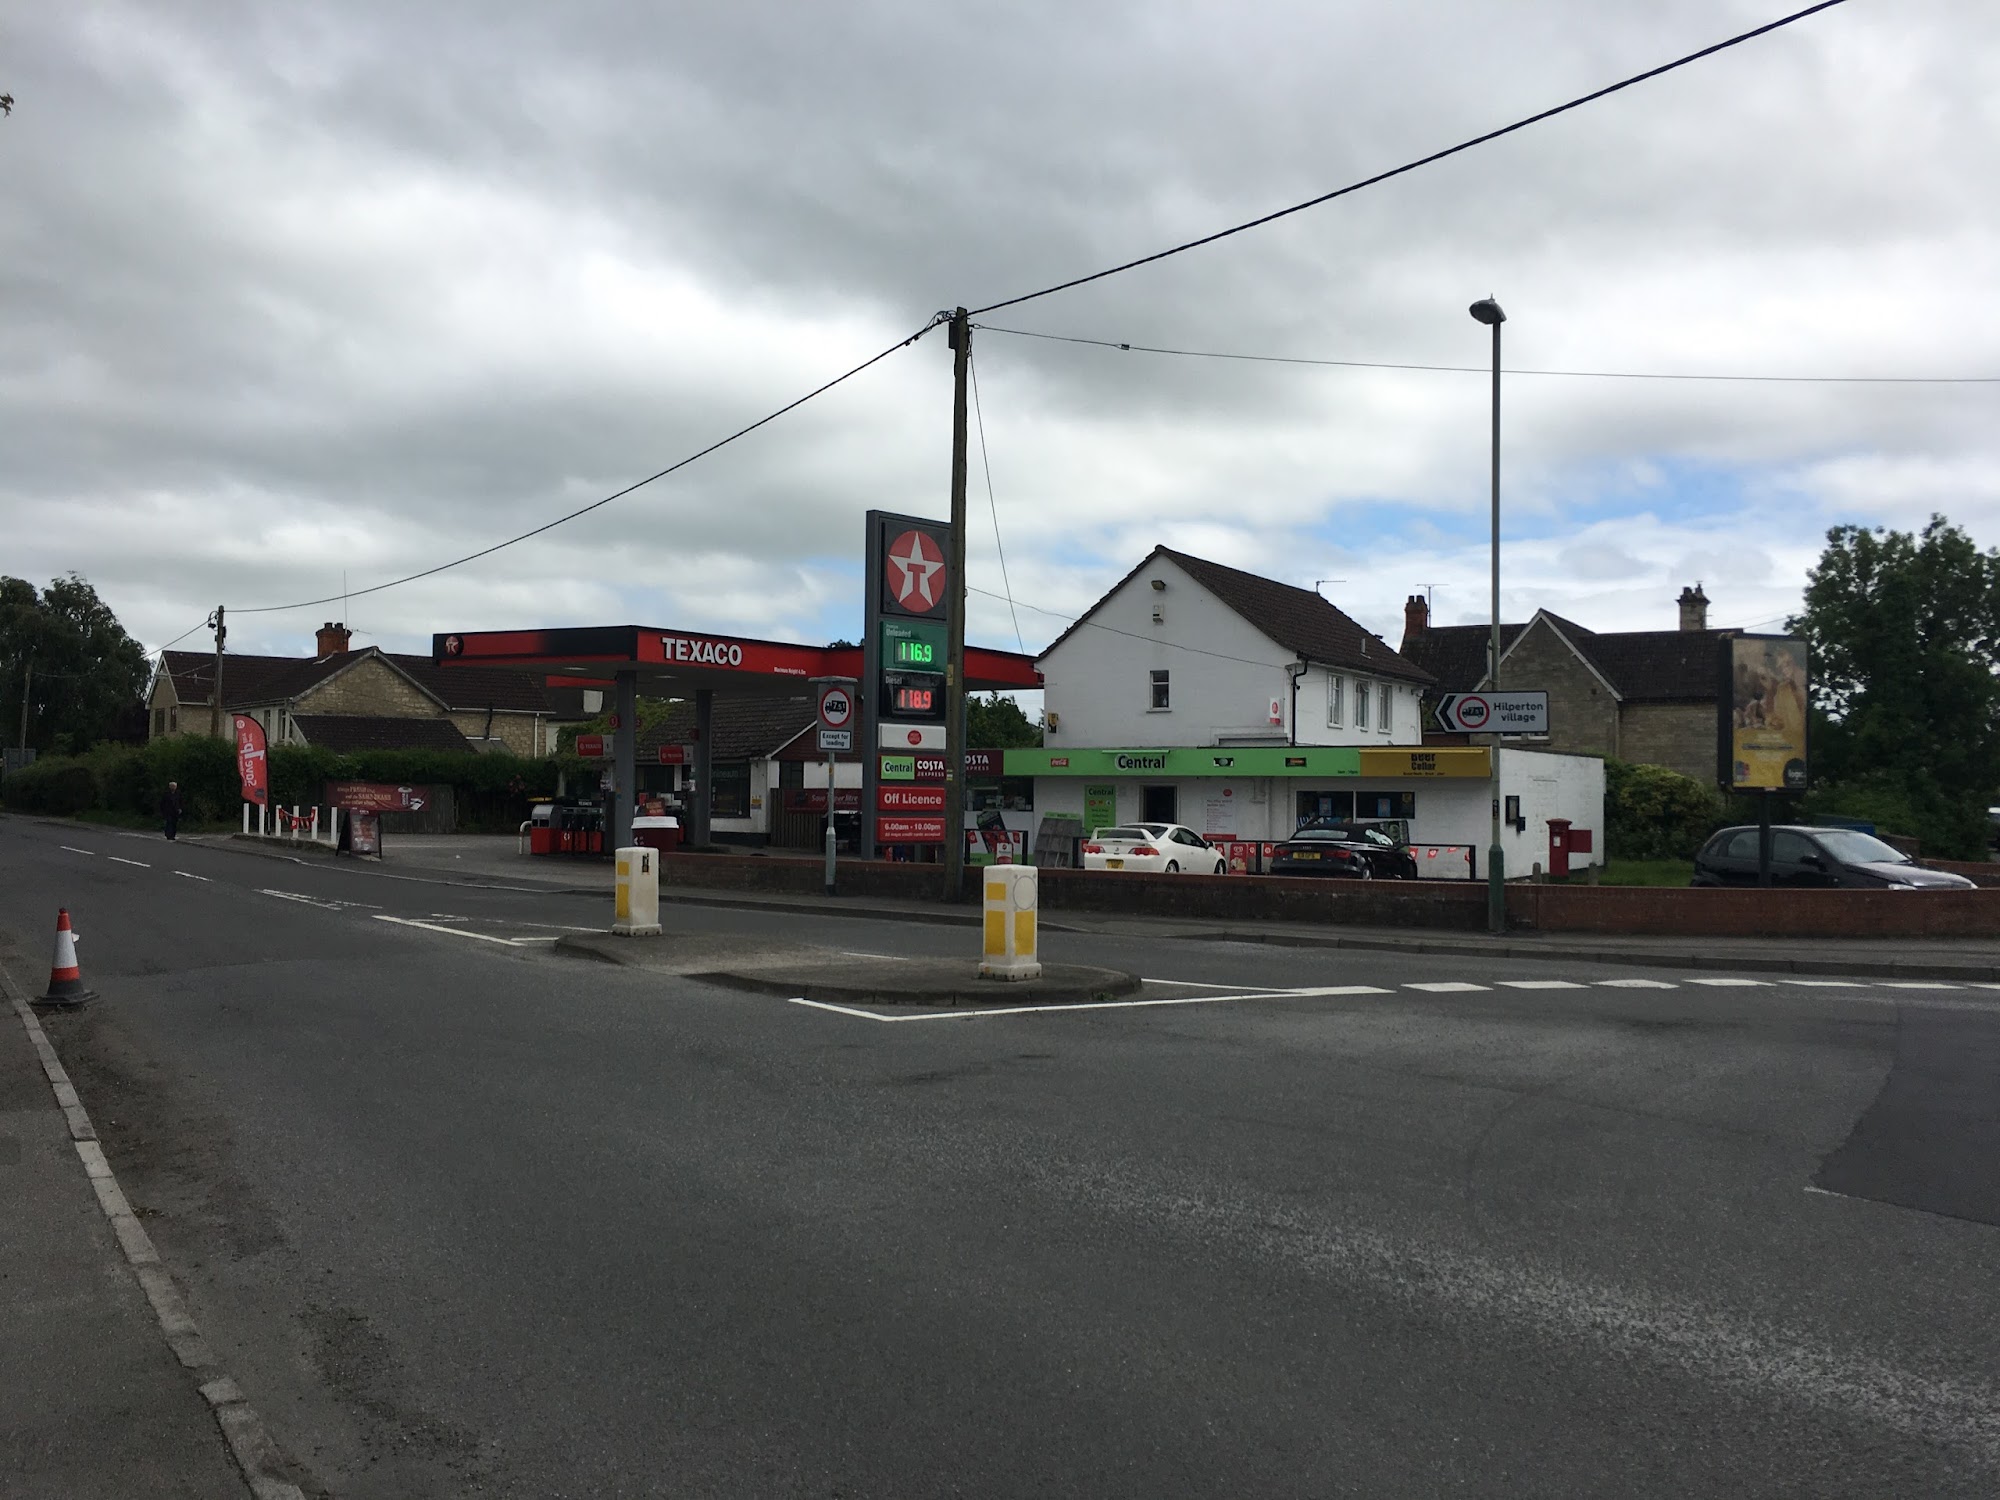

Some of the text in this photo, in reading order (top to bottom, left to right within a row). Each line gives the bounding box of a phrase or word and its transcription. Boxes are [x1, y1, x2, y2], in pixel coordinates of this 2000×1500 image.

[886, 628, 911, 638] Unleaded
[662, 637, 743, 666] TEXACO
[901, 642, 932, 662] 116.9
[885, 675, 902, 685] Diesel
[900, 689, 932, 709] 118.9
[1493, 702, 1544, 712] Hilperton
[1501, 713, 1536, 722] village
[964, 754, 989, 765] OSTA
[1117, 754, 1165, 769] Central
[884, 761, 913, 772] Central
[917, 760, 944, 771] COSTA
[1411, 761, 1436, 771] Cellar
[1088, 788, 1114, 796] Central
[811, 794, 826, 802] Save
[845, 794, 859, 802] litre
[884, 793, 942, 805] Off Licence
[884, 822, 909, 831] 6.00am
[914, 822, 941, 832] 10.00pm
